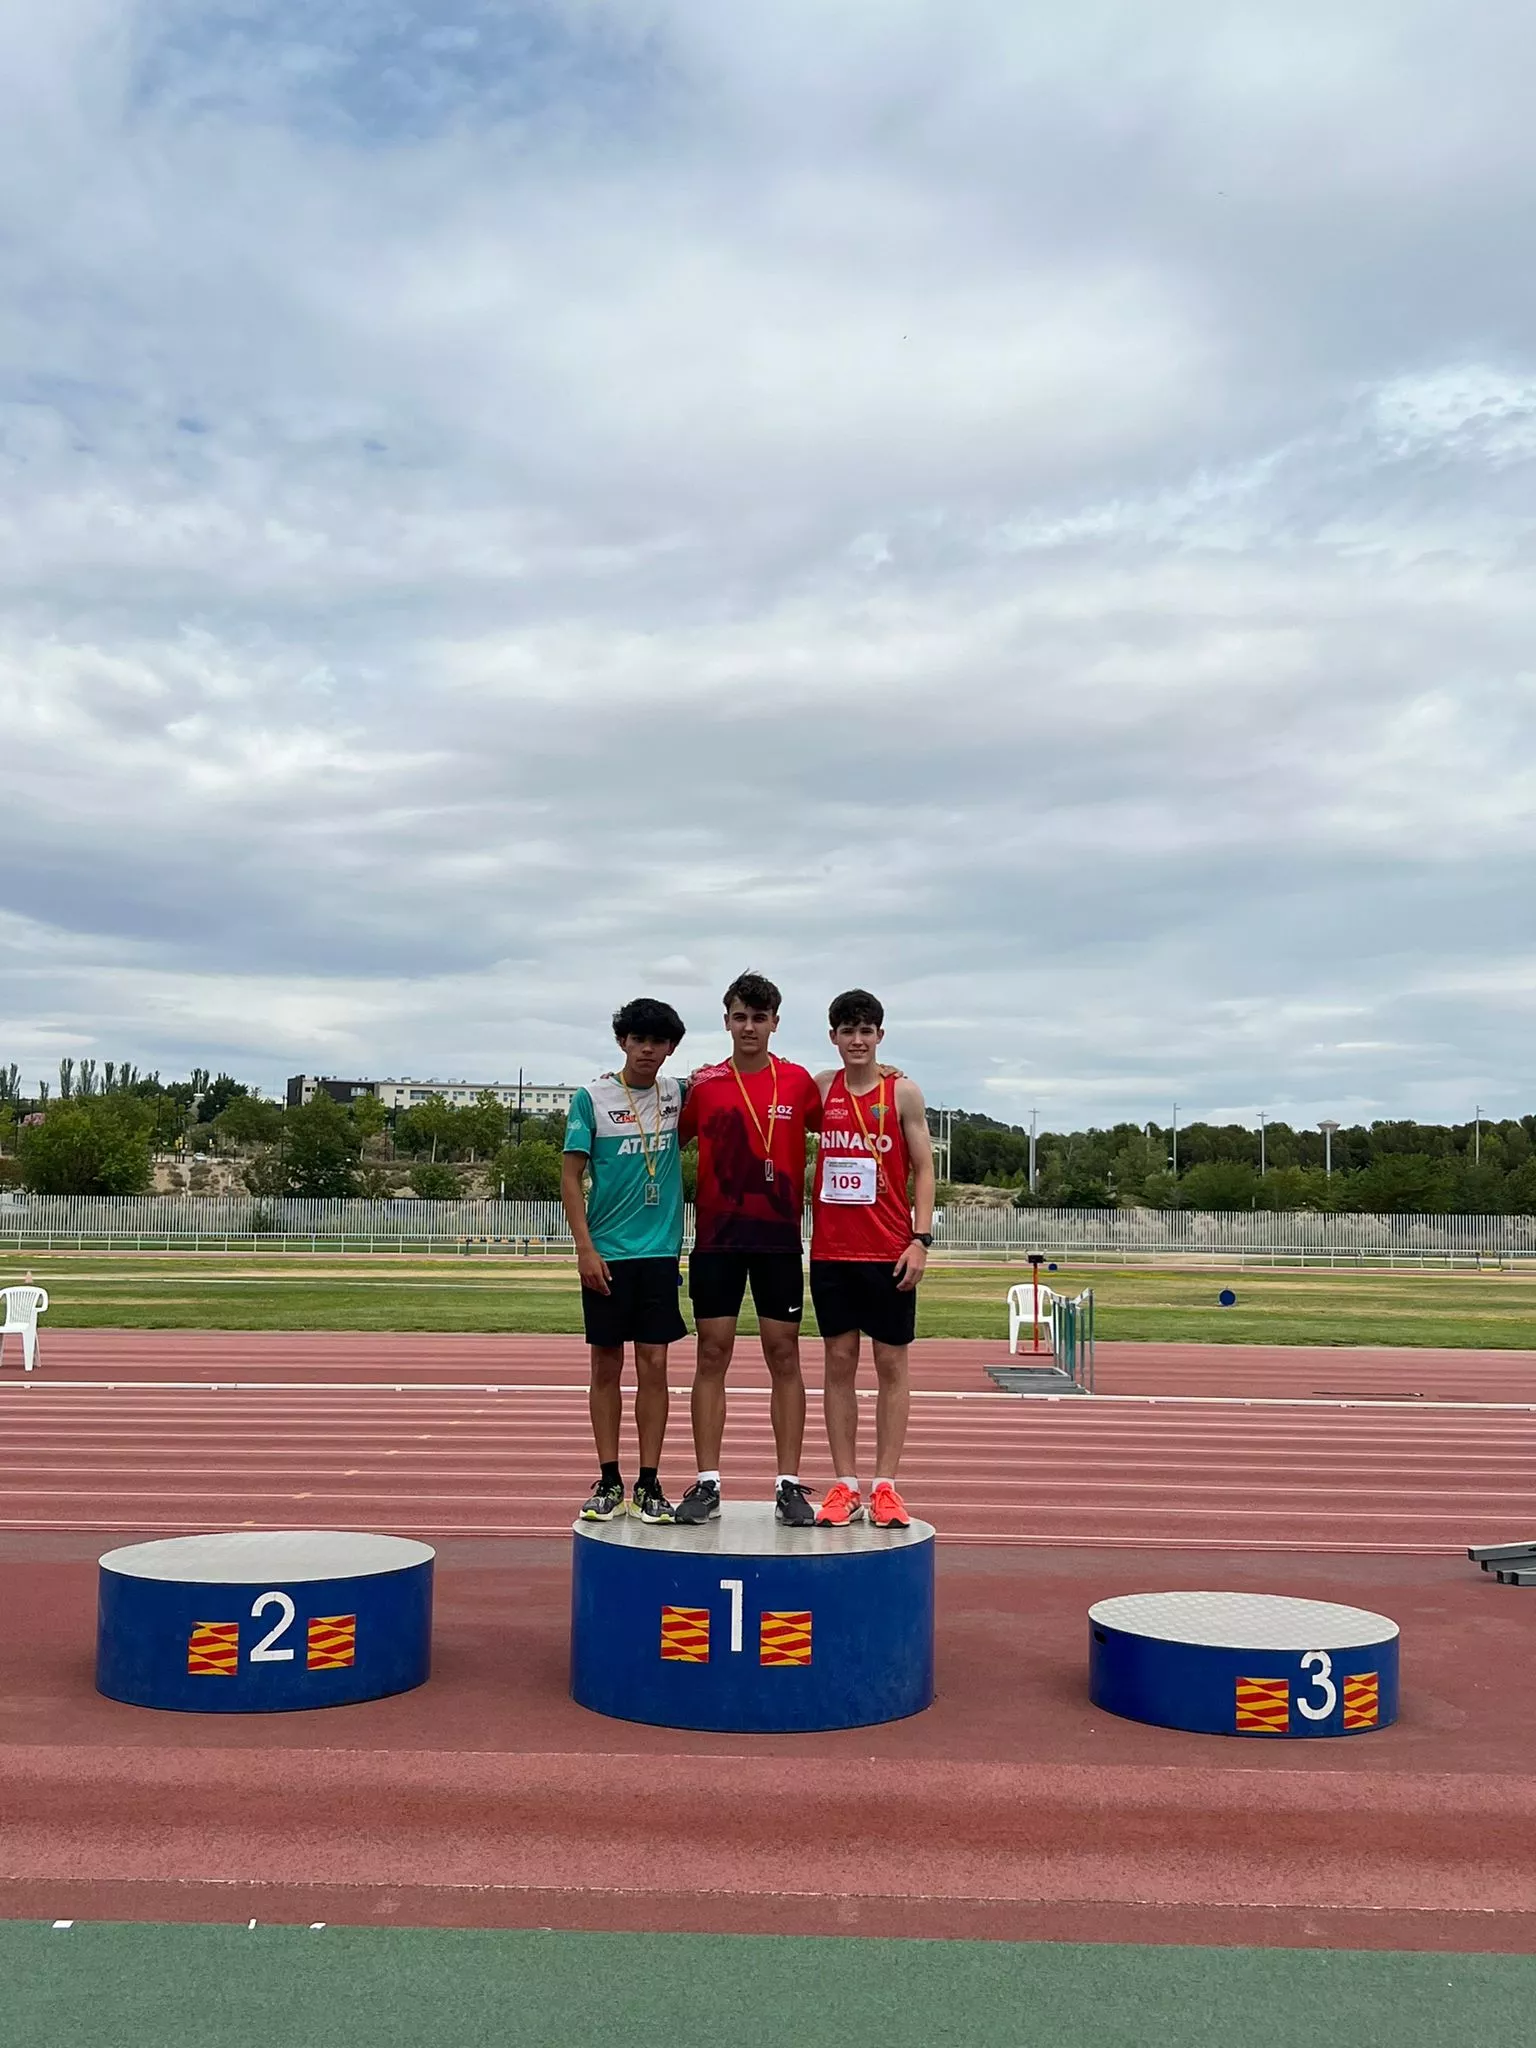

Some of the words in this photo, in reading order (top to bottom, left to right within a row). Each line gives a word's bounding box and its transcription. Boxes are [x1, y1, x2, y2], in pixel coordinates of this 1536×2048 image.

[767, 1104, 793, 1115] ZGZ
[821, 1130, 893, 1153] HINACO
[831, 1175, 861, 1190] 109
[250, 1591, 295, 1662] 2
[720, 1580, 743, 1652] 1
[1297, 1651, 1337, 1720] 3
